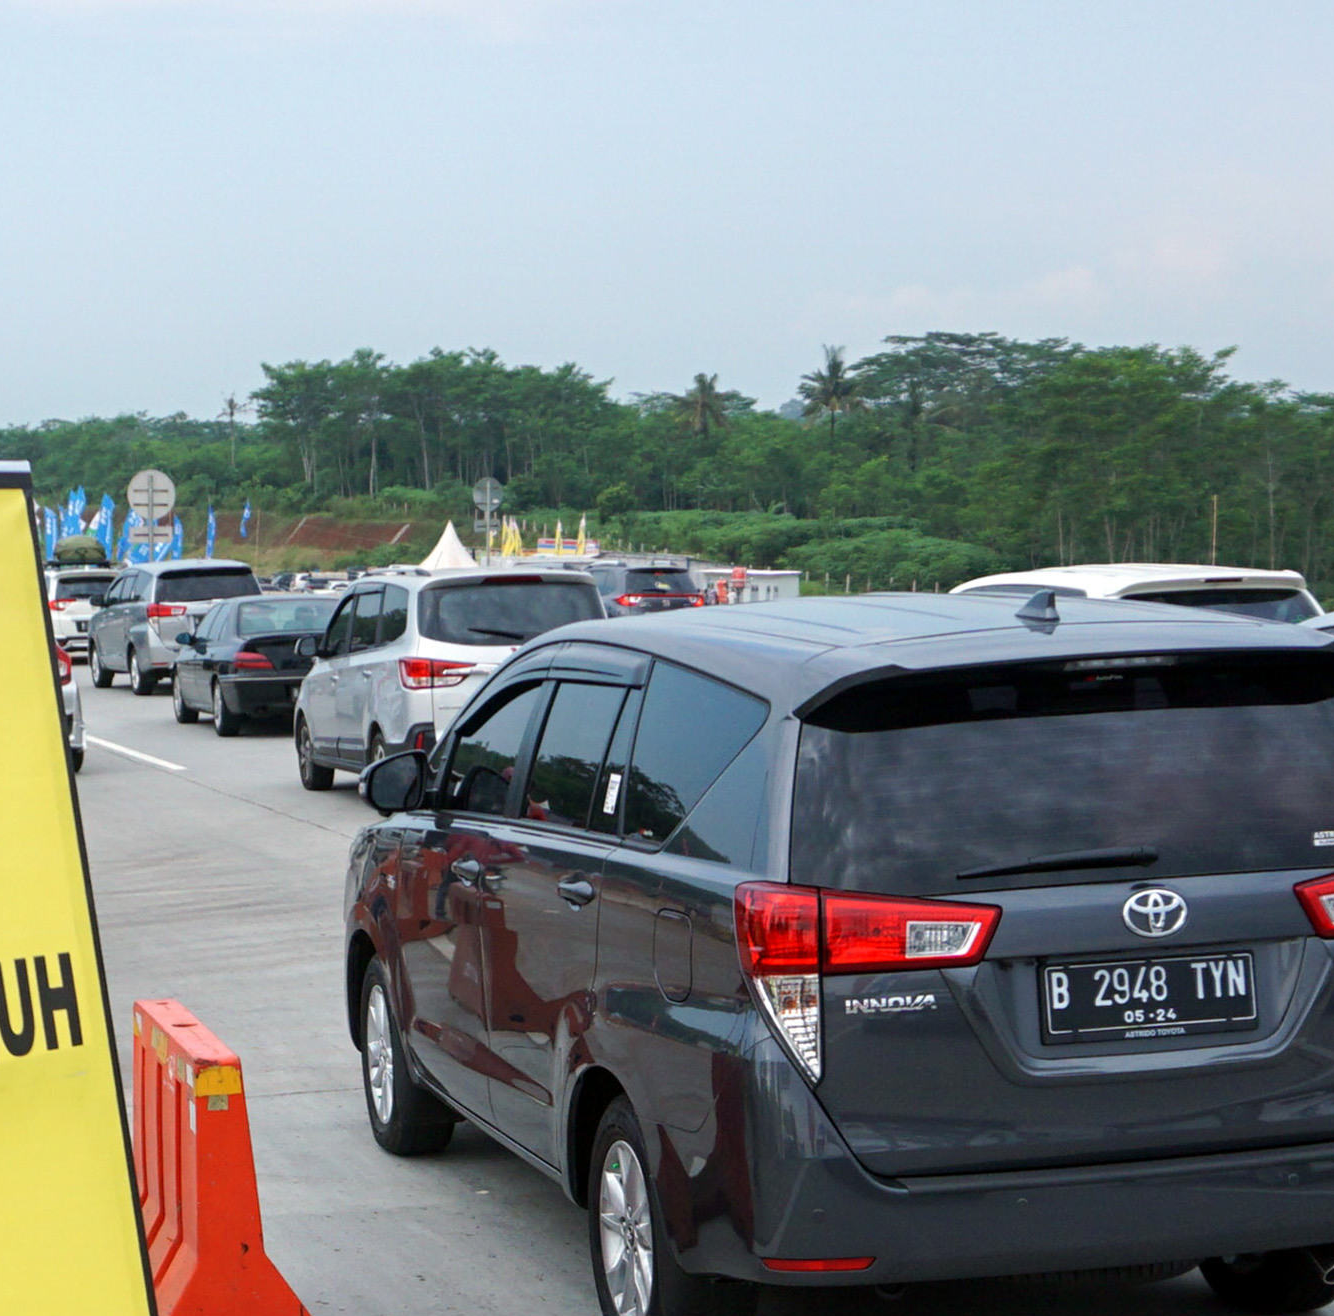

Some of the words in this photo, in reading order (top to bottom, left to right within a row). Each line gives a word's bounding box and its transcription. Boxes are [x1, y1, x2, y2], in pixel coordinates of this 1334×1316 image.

[1050, 971, 1070, 1010] B
[1093, 965, 1168, 1007] 2948
[1190, 959, 1247, 1000] TYN
[845, 994, 937, 1015] INNOVA
[1124, 1029, 1157, 1039] ASTRIDO
[1157, 1027, 1186, 1036] TOYOTA
